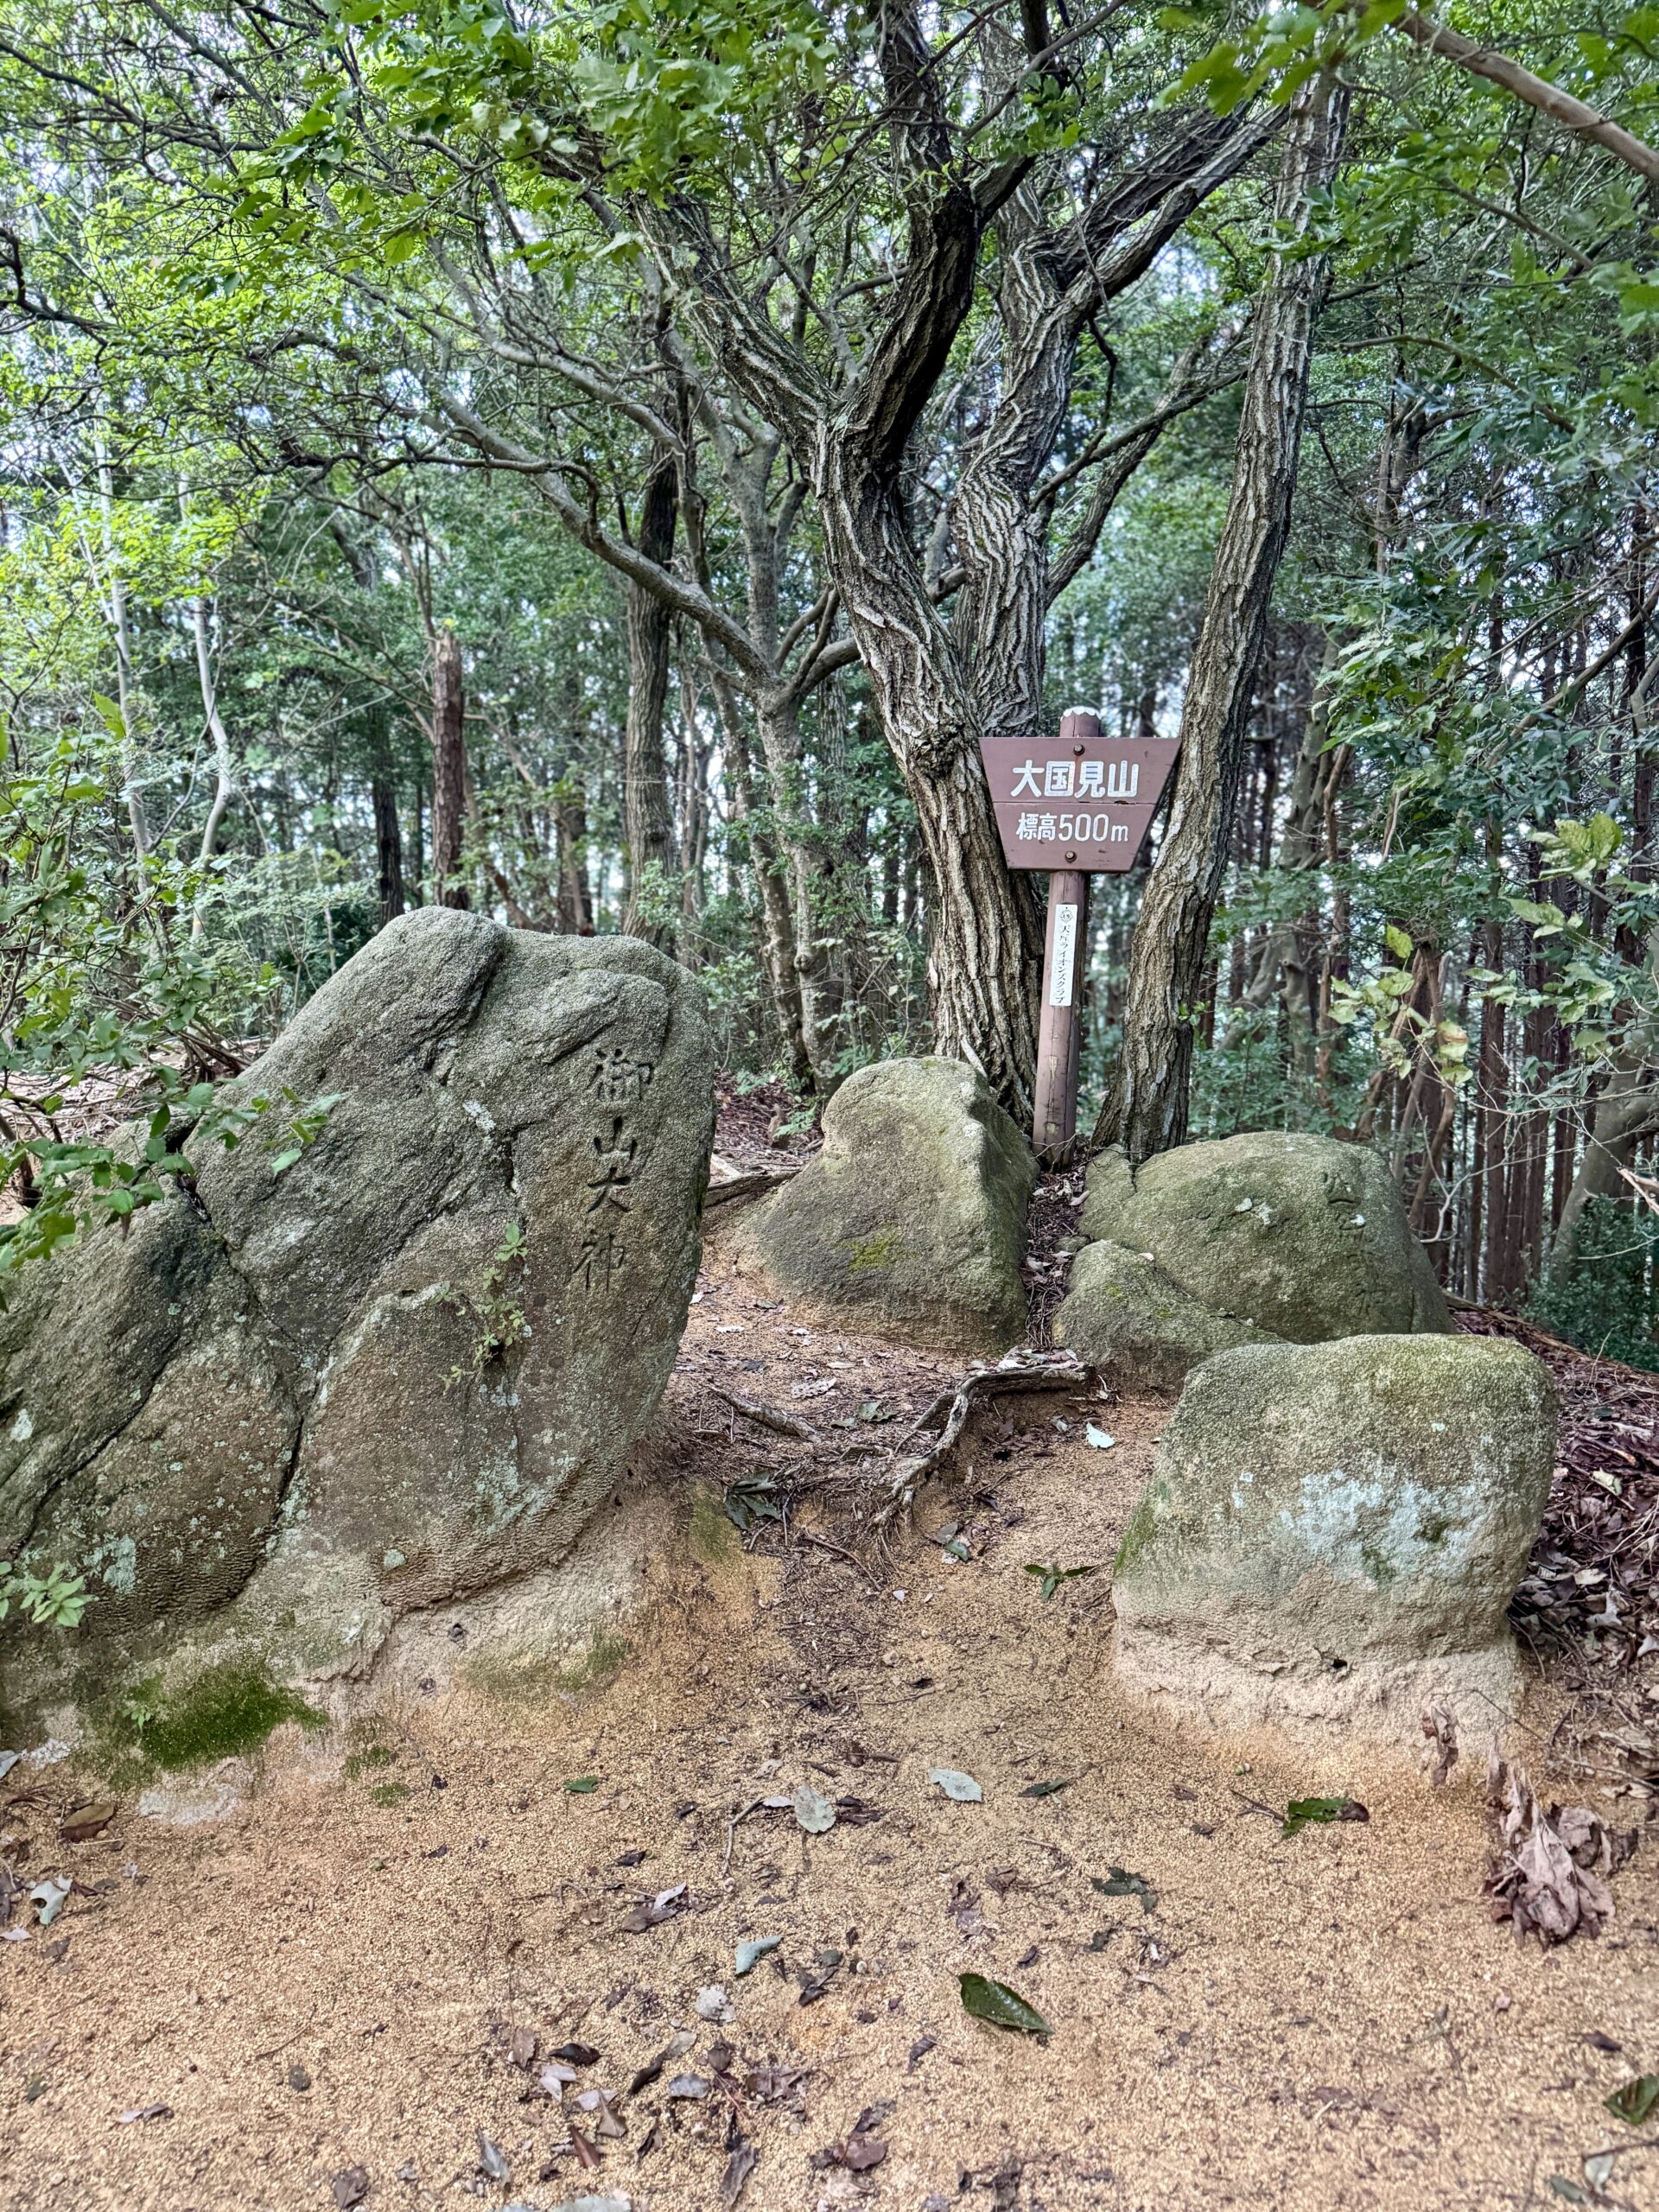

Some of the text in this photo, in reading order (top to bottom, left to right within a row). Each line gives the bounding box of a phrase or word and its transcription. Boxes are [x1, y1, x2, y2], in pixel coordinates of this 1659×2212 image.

[1010, 760, 1140, 798] 大国見山
[1016, 812, 1128, 842] 標高500m
[572, 1048, 655, 1292] 御山大神
